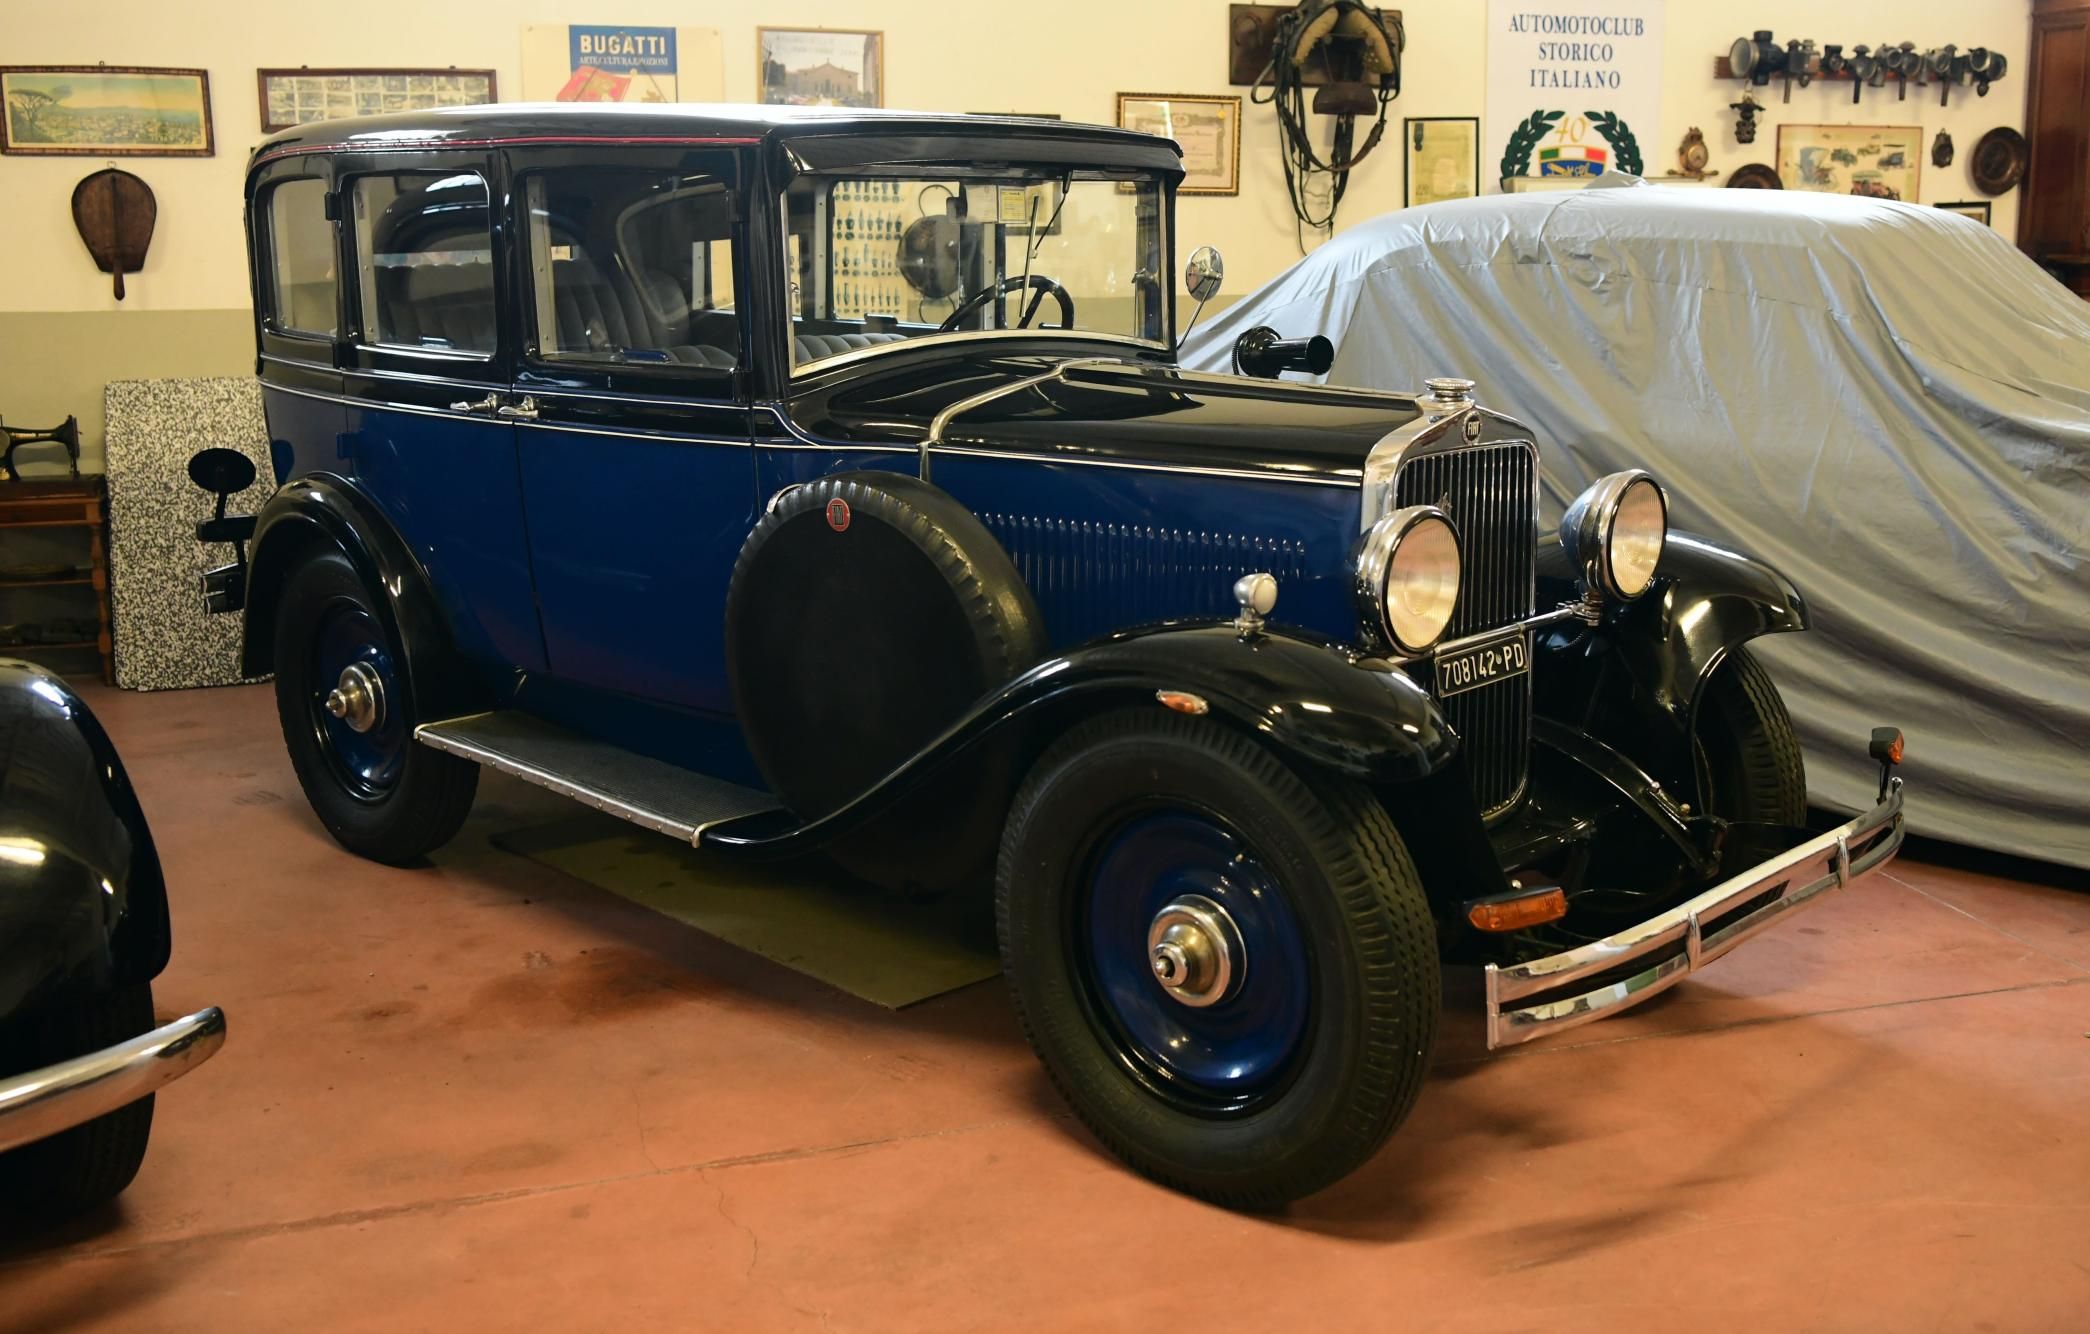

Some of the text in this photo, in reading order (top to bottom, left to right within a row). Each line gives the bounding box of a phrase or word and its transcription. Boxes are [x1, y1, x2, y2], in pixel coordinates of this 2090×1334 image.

[1509, 14, 1644, 36] AUTOMOTOCLUB
[580, 35, 665, 55] BUGATTI
[1538, 42, 1613, 62] STORICO
[1530, 69, 1621, 89] ITALIANO
[1555, 117, 1588, 143] 40
[1443, 643, 1524, 689] 708142 PD
